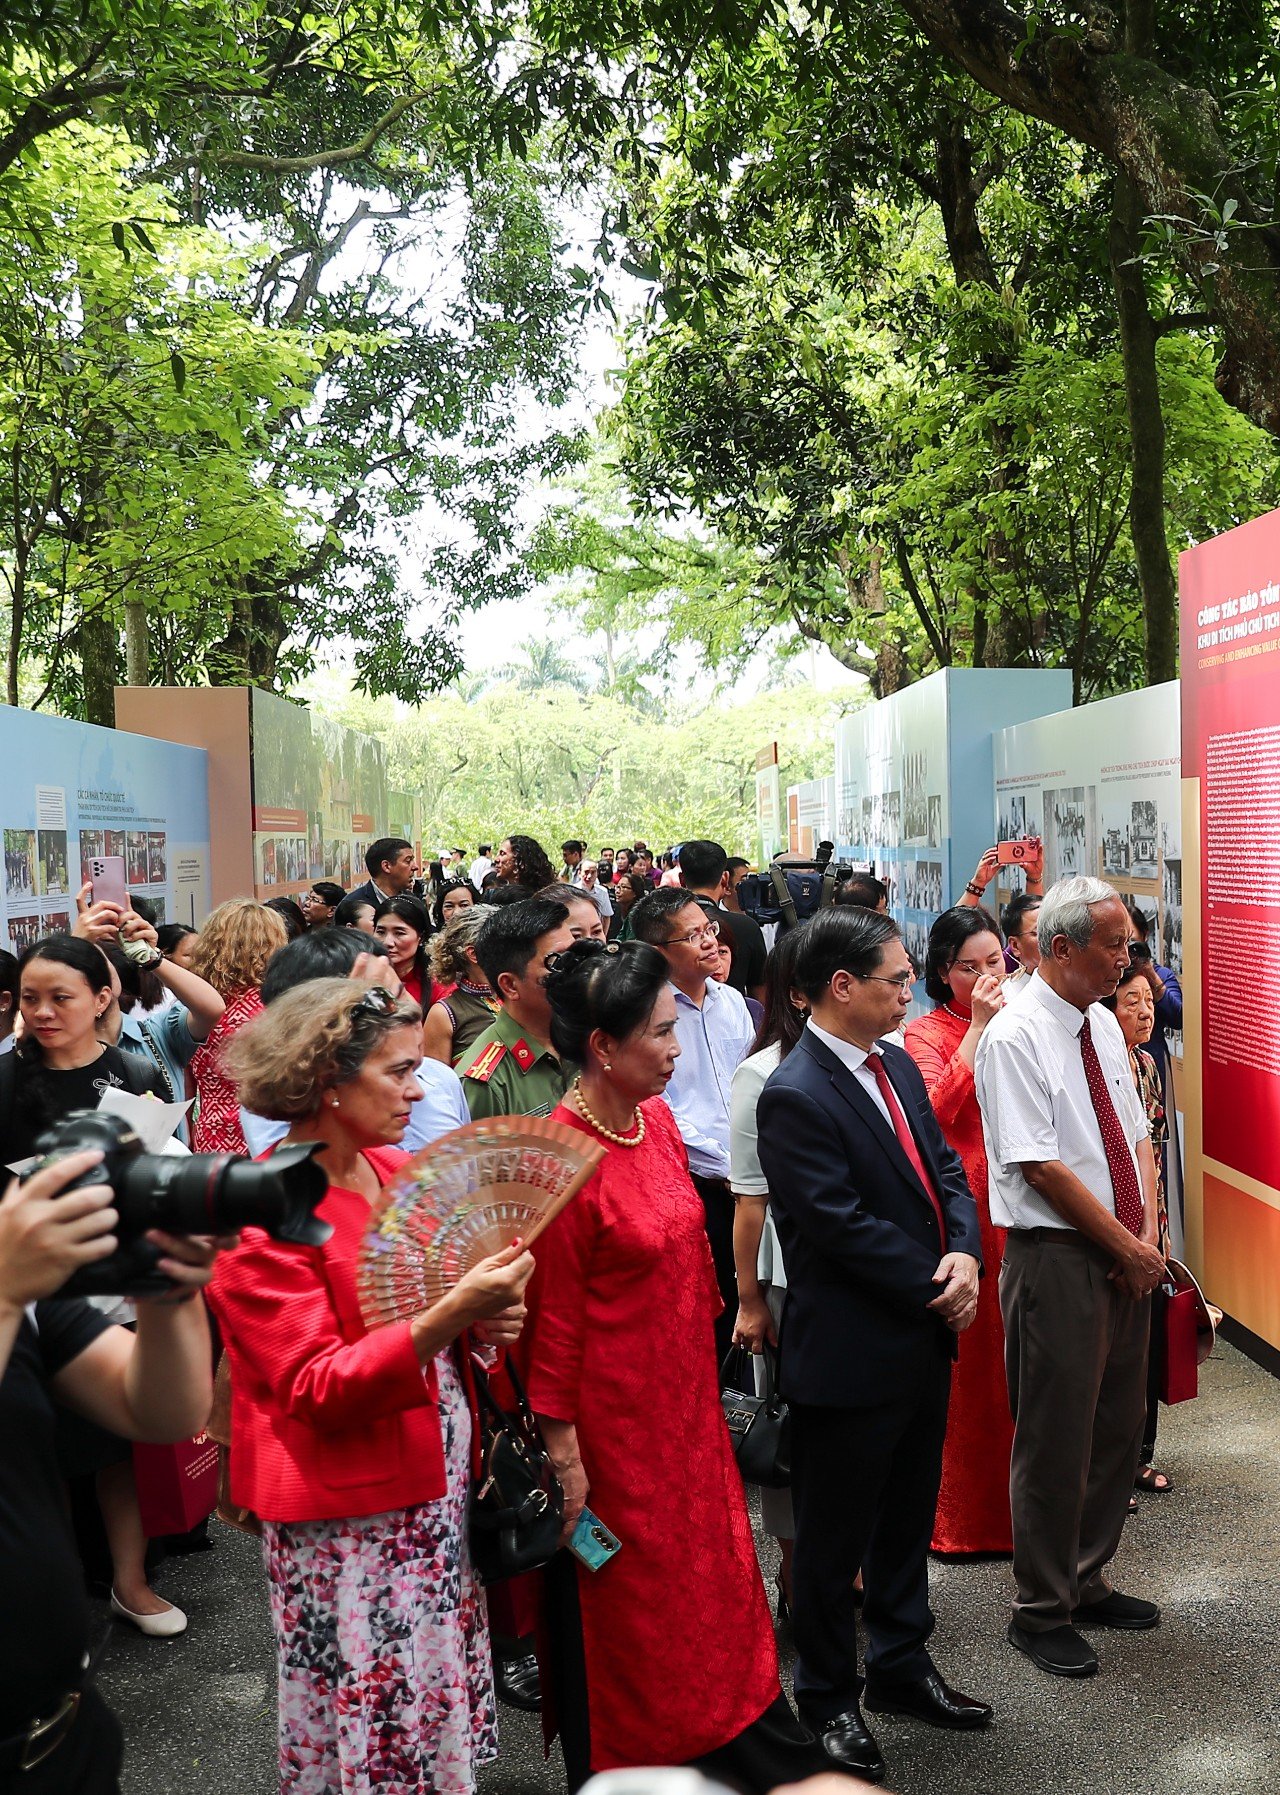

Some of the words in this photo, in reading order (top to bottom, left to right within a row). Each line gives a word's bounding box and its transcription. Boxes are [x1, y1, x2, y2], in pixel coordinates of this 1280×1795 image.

[1222, 598, 1238, 619] TÁC
[1198, 633, 1210, 649] KHU
[1211, 631, 1218, 645] DI
[1264, 612, 1279, 632] TỊCH
